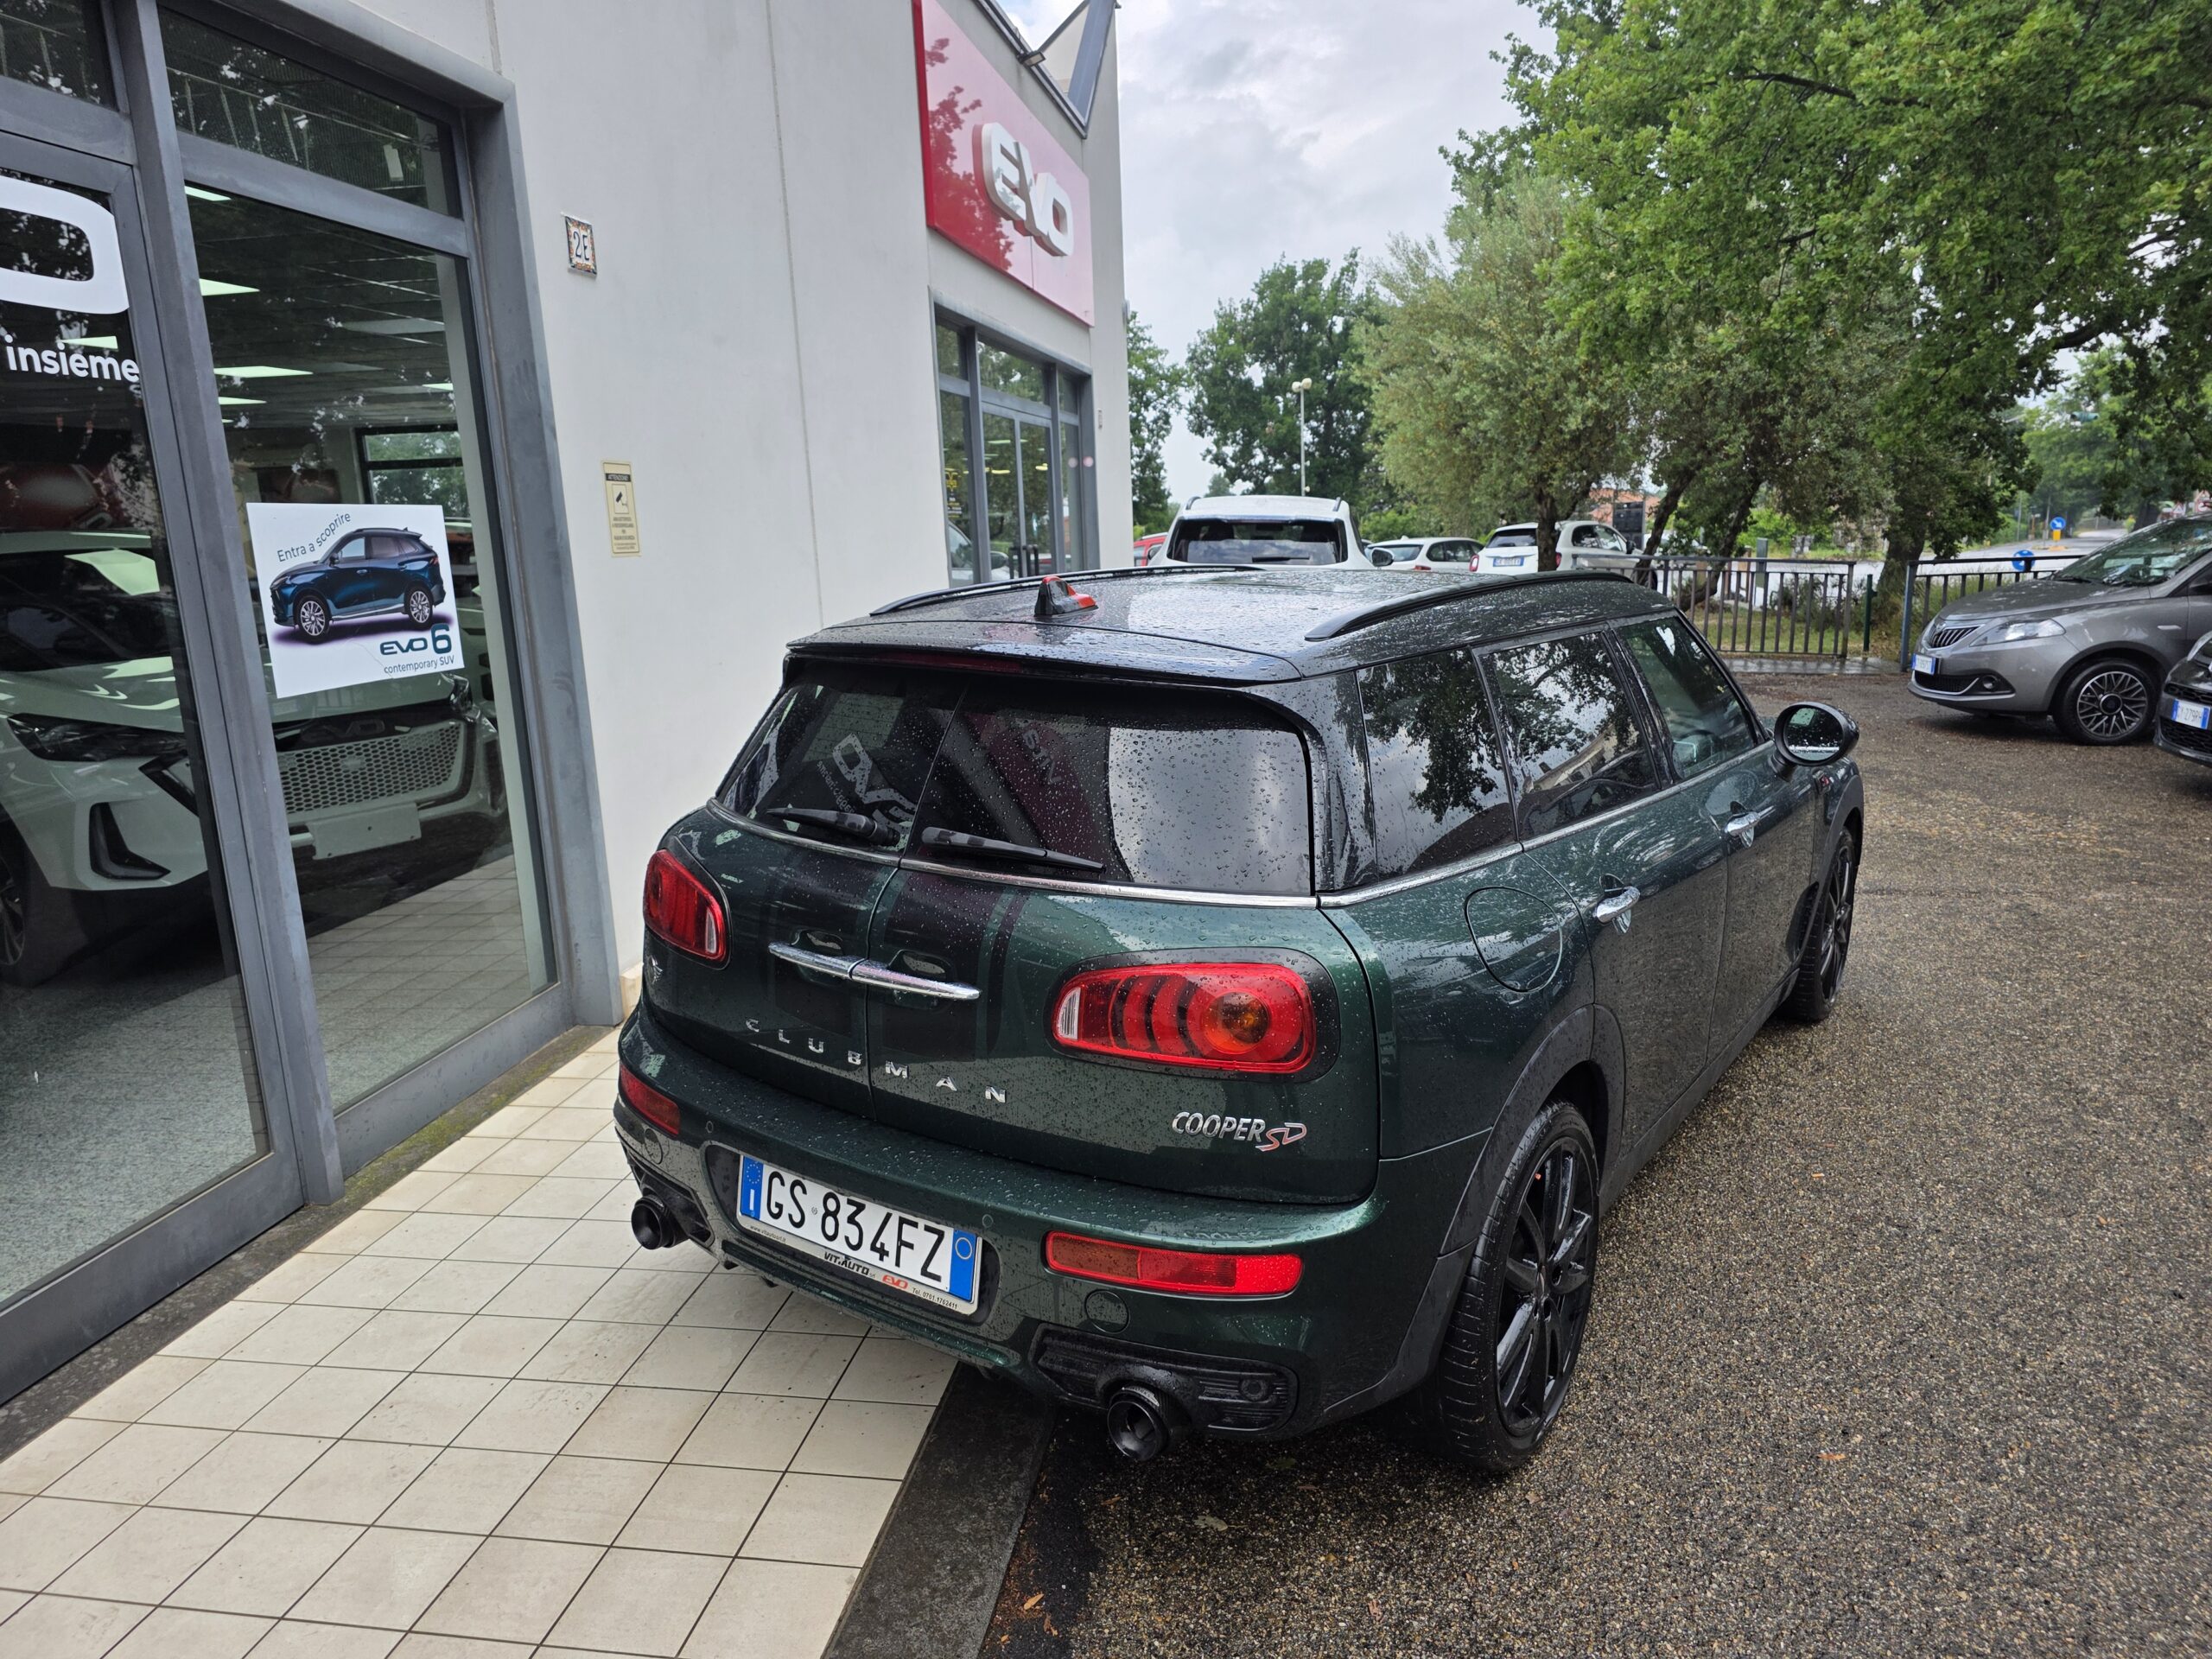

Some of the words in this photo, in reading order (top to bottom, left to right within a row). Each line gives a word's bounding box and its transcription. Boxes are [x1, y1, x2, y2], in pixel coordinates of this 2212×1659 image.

[975, 122, 1074, 256] EVO
[573, 230, 590, 261] 2E
[5, 334, 140, 383] insieme
[276, 544, 308, 563] Entra
[308, 542, 316, 552] a
[315, 512, 352, 547] scoprire
[379, 637, 429, 656] EVO
[430, 622, 453, 655] 6
[384, 658, 438, 674] contemporary
[439, 655, 455, 666] SUV
[745, 1018, 1007, 1104] CLUBMAN
[1172, 1111, 1266, 1143] COOPER
[1255, 1122, 1307, 1152] SD
[766, 1170, 808, 1229] GS
[820, 1192, 946, 1283] 834FZ
[881, 1274, 909, 1290] EVO
